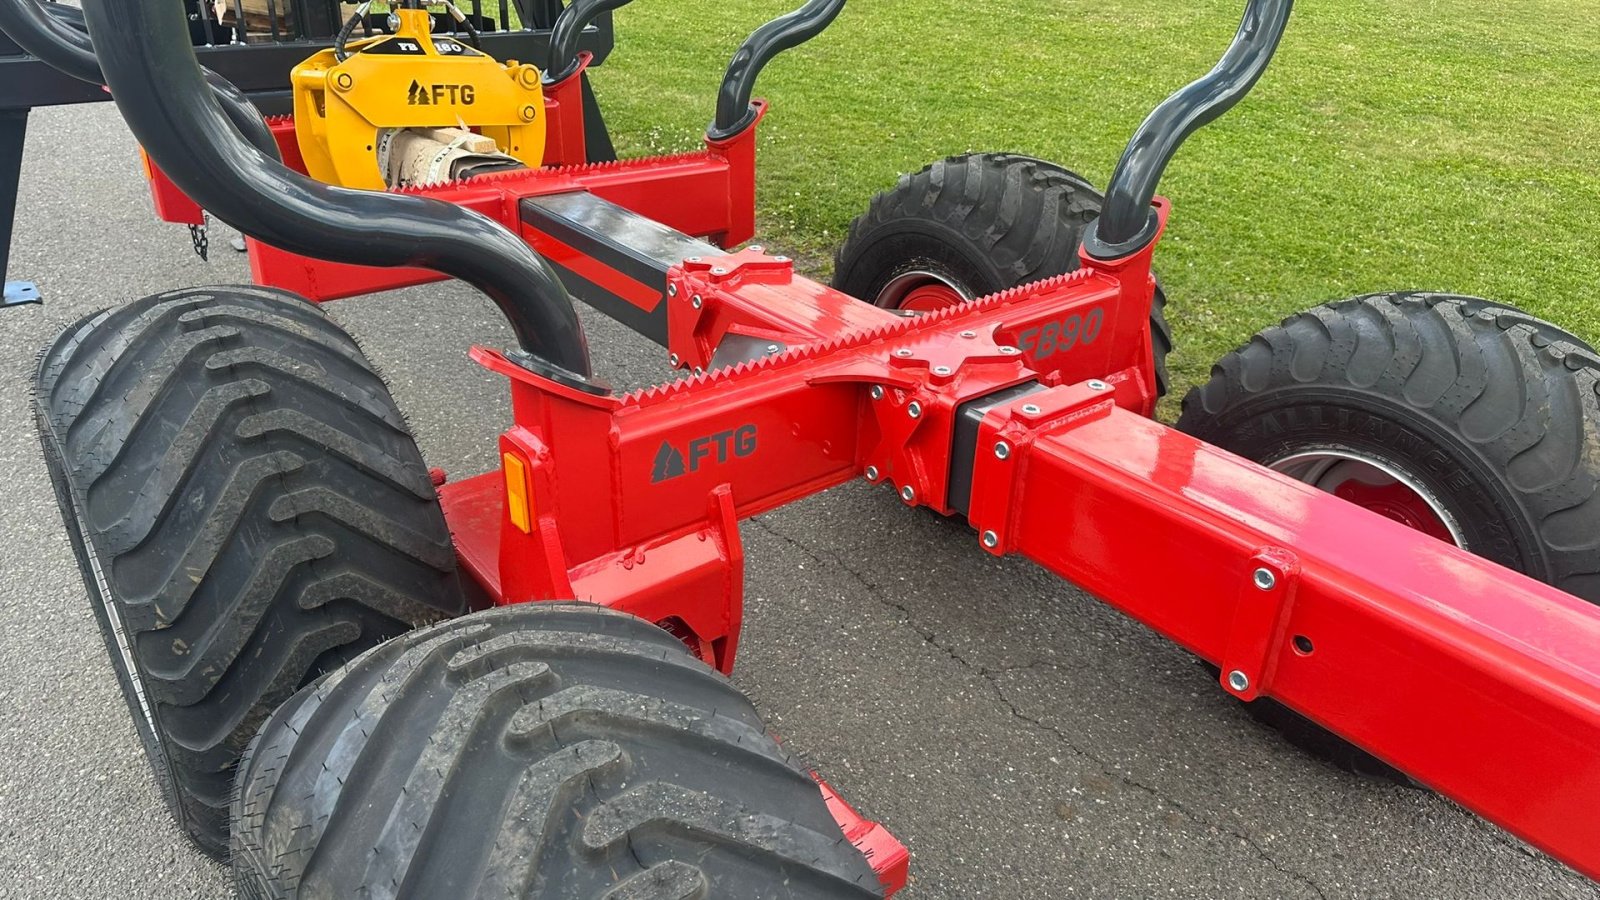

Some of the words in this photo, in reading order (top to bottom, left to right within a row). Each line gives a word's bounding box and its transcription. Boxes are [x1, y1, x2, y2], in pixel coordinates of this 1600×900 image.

[431, 84, 475, 105] FTG
[1018, 307, 1104, 360] FB90
[688, 423, 758, 473] FTG
[1260, 404, 1474, 493] ALLIANCE
